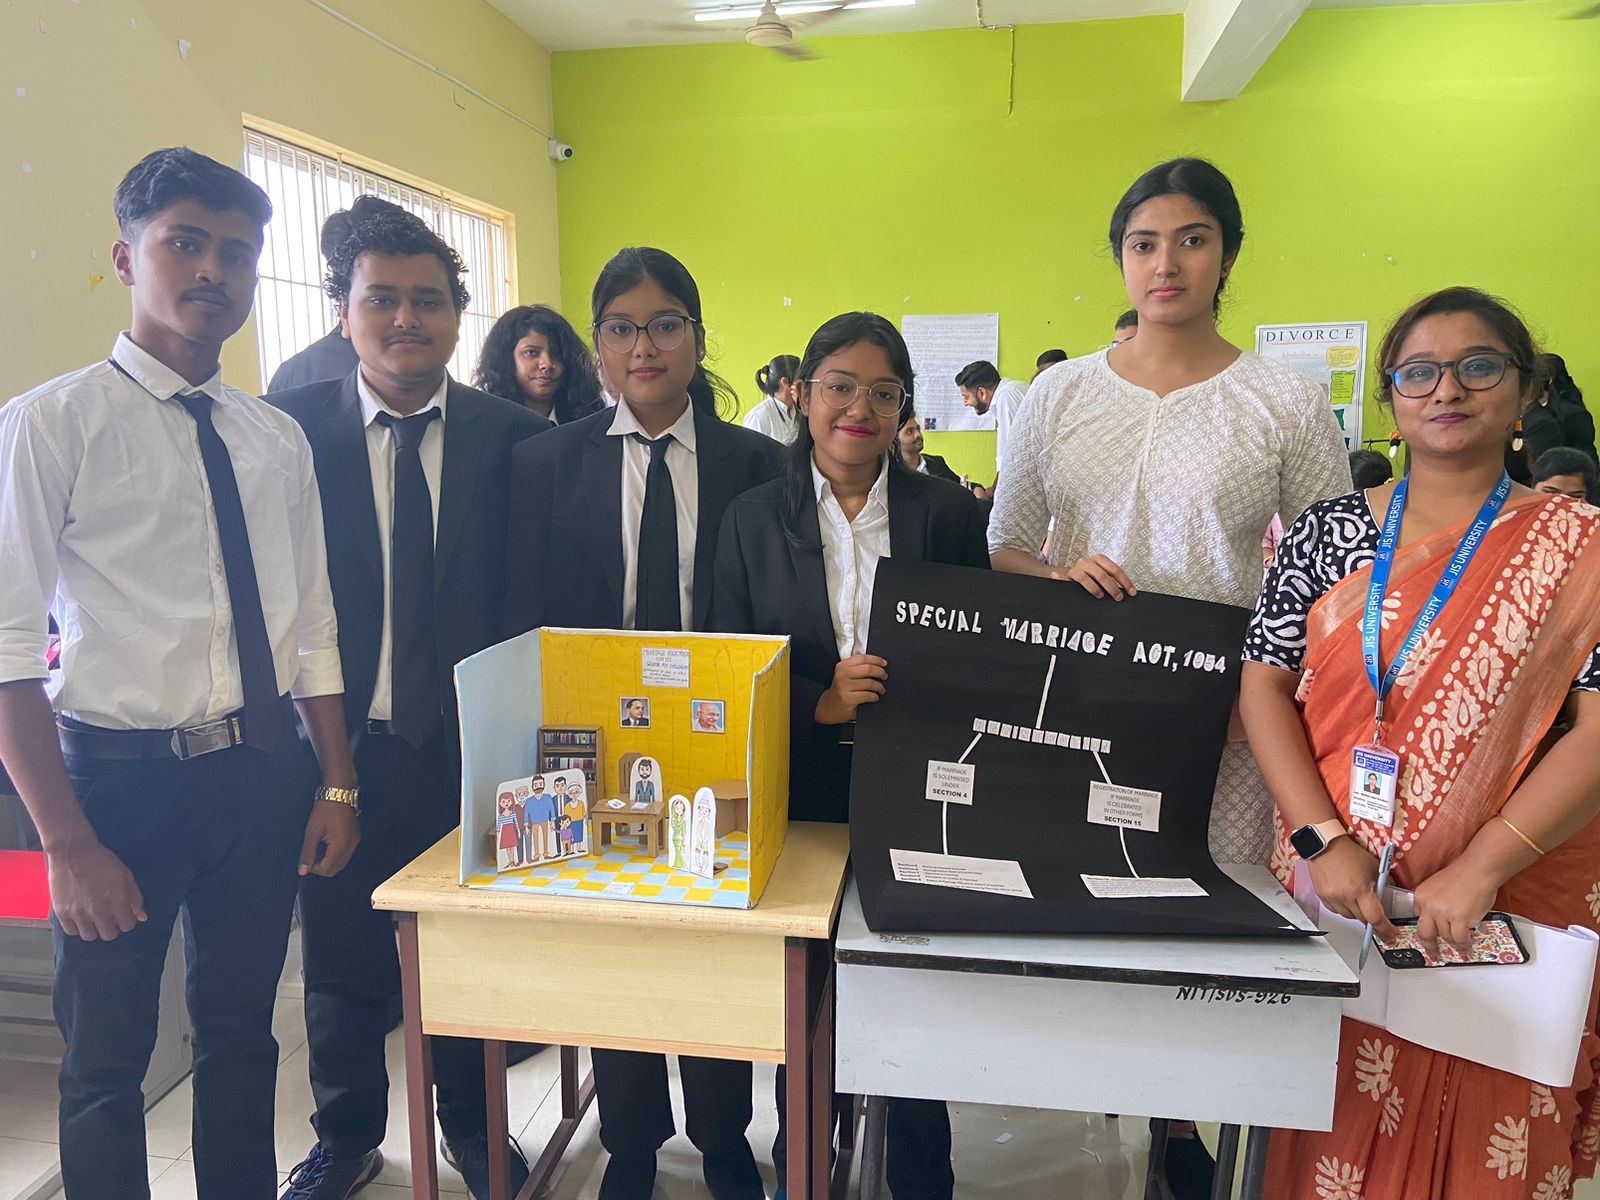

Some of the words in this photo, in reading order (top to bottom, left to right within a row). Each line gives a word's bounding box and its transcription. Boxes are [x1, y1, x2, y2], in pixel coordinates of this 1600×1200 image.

[1266, 328, 1354, 342] DIVORCE
[1385, 494, 1403, 538] UNIVERSITY
[1381, 538, 1393, 549] JIS
[1455, 519, 1487, 564] UNIVERSITY
[1449, 563, 1462, 576] JIS
[1366, 582, 1383, 634] UNIVERSITY
[1399, 648, 1412, 662] JIS
[1406, 595, 1442, 650] UNIVERSITY
[895, 600, 982, 633] SPECIAL
[1000, 617, 1114, 656] MARRIAGE
[1183, 649, 1226, 673] 1954
[1365, 635, 1375, 649] JIS
[932, 788, 962, 797] SECTION
[1115, 794, 1141, 803] MARRIAGE
[1134, 790, 1159, 799] MARRIAGE
[1112, 801, 1143, 811] CELEBRATED
[1104, 815, 1132, 825] SECTION
[1126, 811, 1144, 819] FORMS
